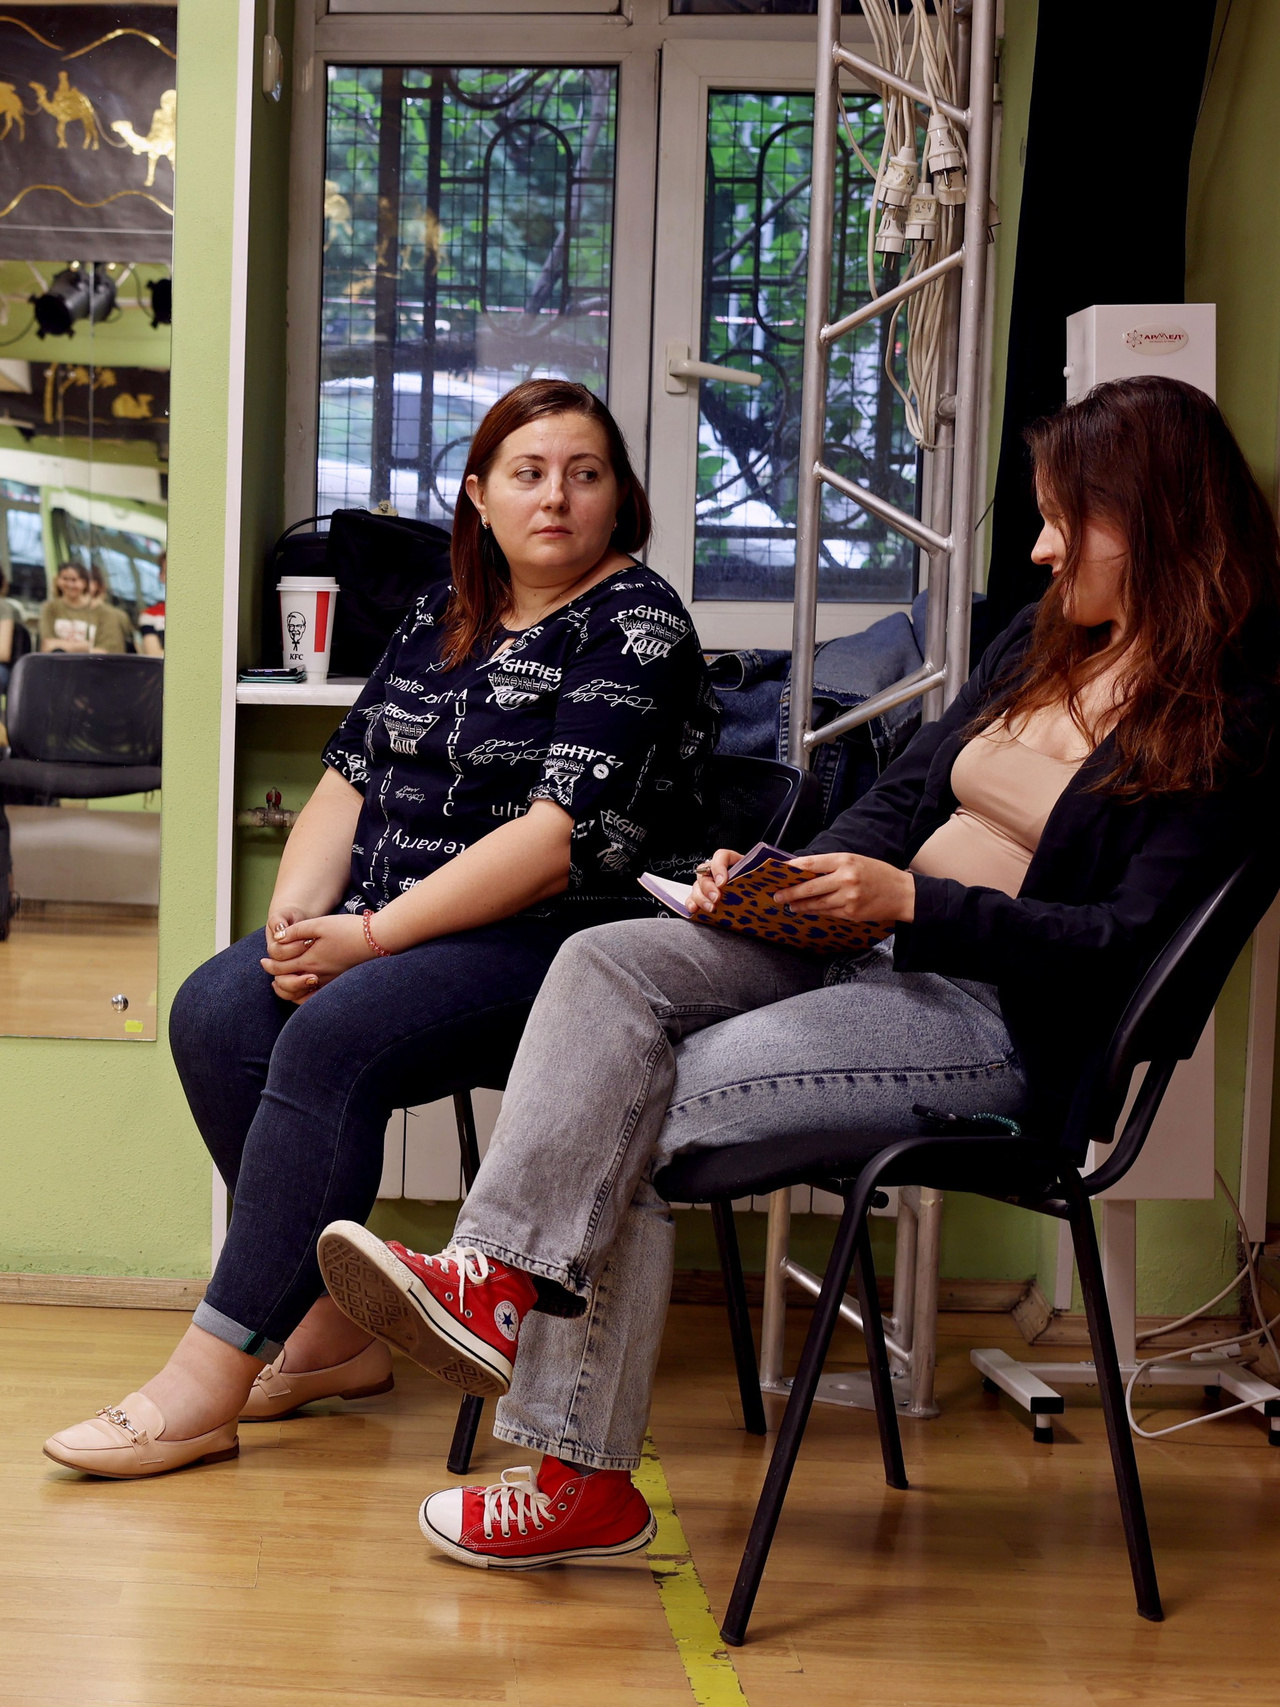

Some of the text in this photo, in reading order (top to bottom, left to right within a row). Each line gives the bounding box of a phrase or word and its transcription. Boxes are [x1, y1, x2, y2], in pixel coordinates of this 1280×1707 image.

[621, 629, 672, 658] Tour
[289, 653, 304, 661] KFC
[502, 659, 562, 683] GHTIES
[443, 688, 468, 816] AUTHENTIC
[392, 828, 443, 852] party
